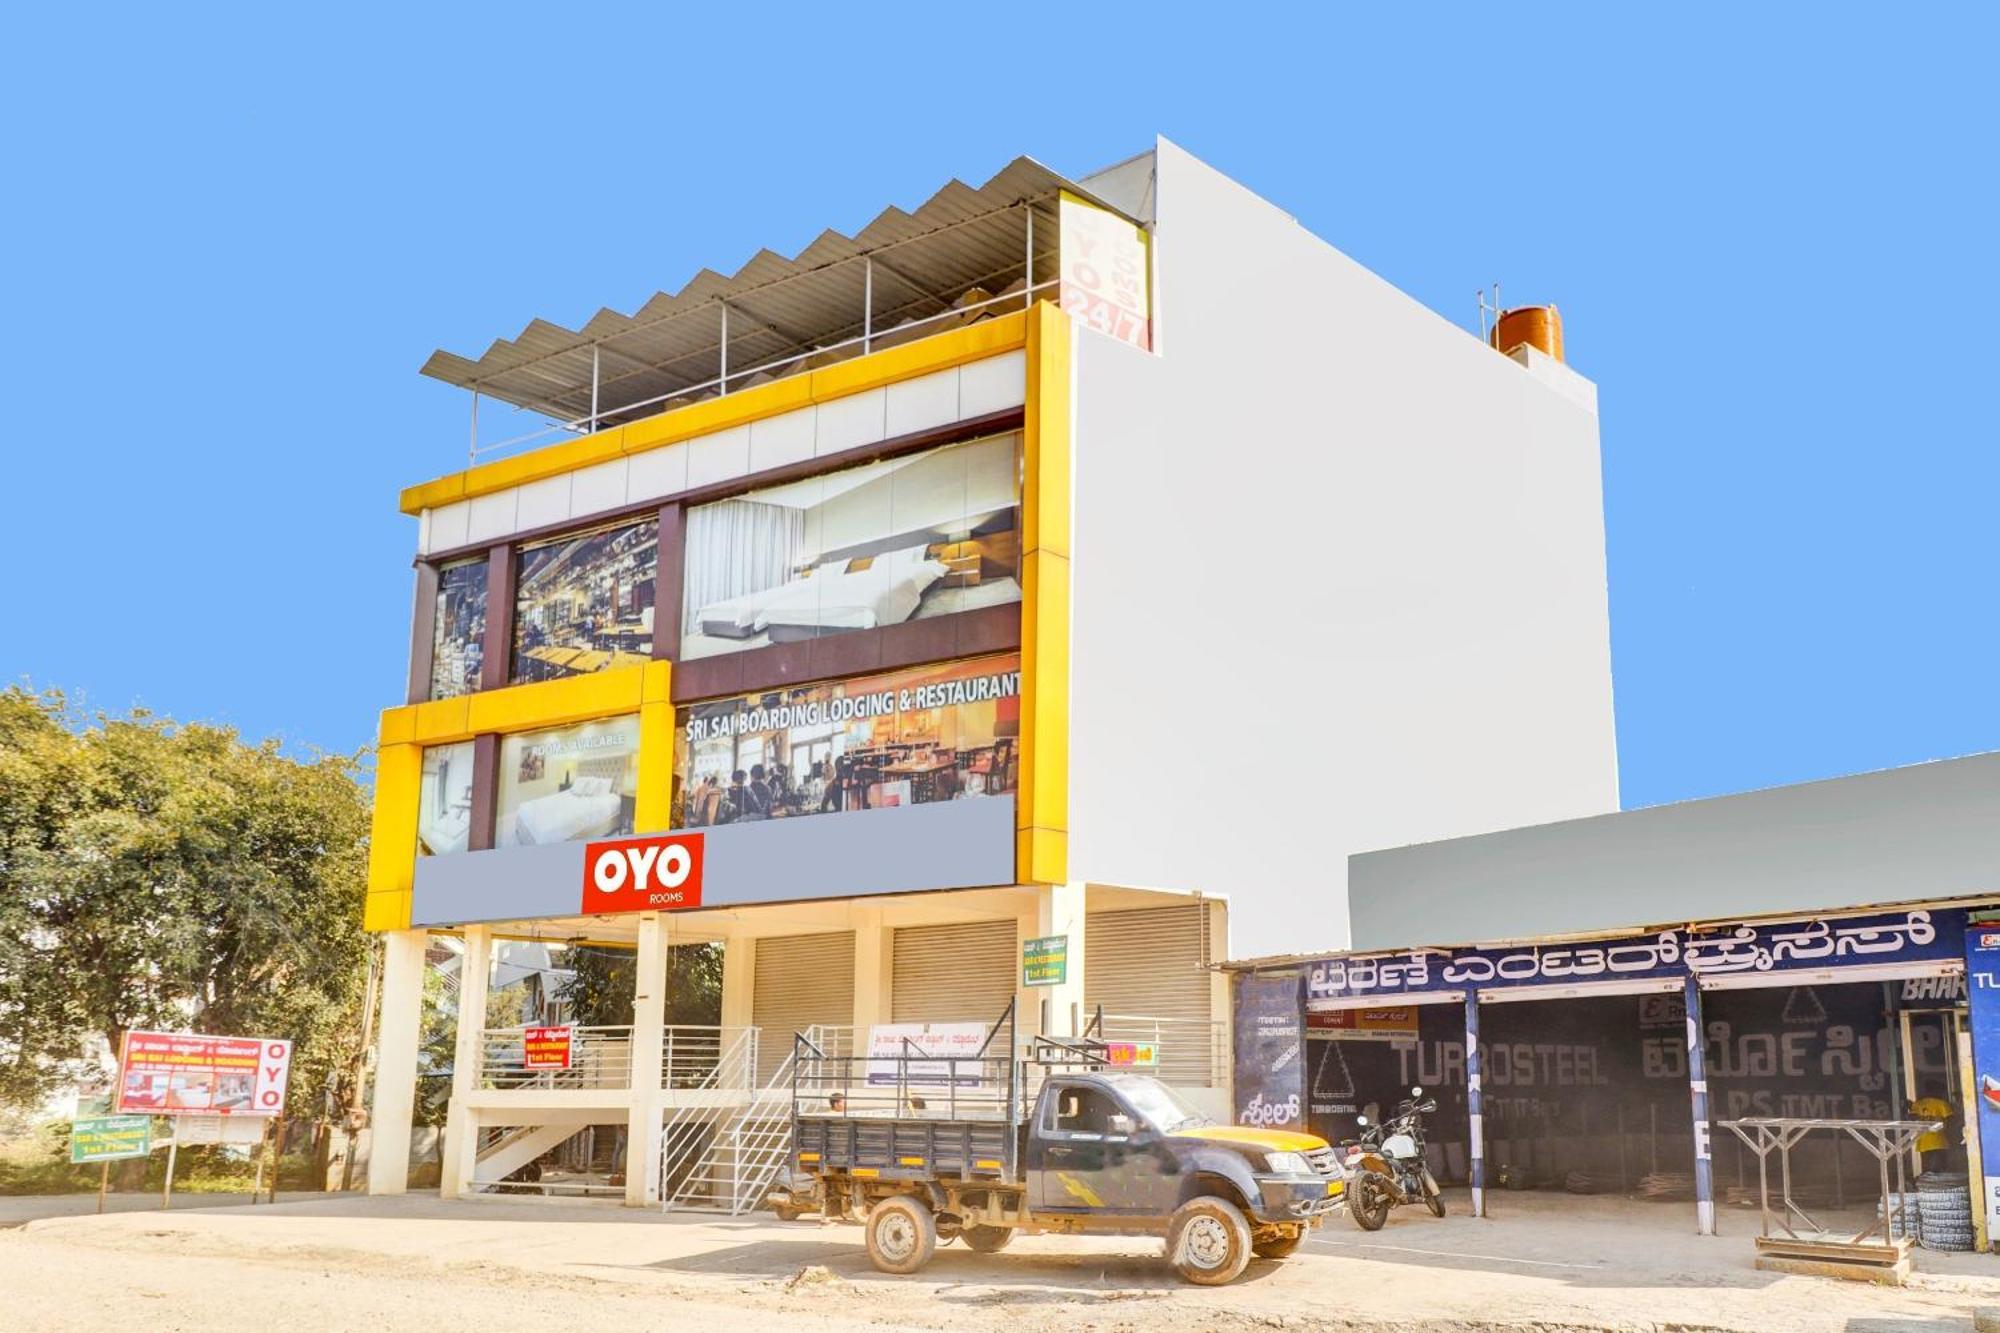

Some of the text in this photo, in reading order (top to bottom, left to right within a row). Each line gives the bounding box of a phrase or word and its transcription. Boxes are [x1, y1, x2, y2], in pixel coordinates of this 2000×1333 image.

[686, 718, 707, 742] SRI
[711, 713, 735, 738] SAI
[739, 701, 818, 735] BOARDING
[822, 690, 894, 723] LODGING
[899, 689, 911, 712] &
[594, 843, 692, 893] OYO
[649, 892, 683, 905] ROOMS
[1902, 972, 1967, 1000] BHAR
